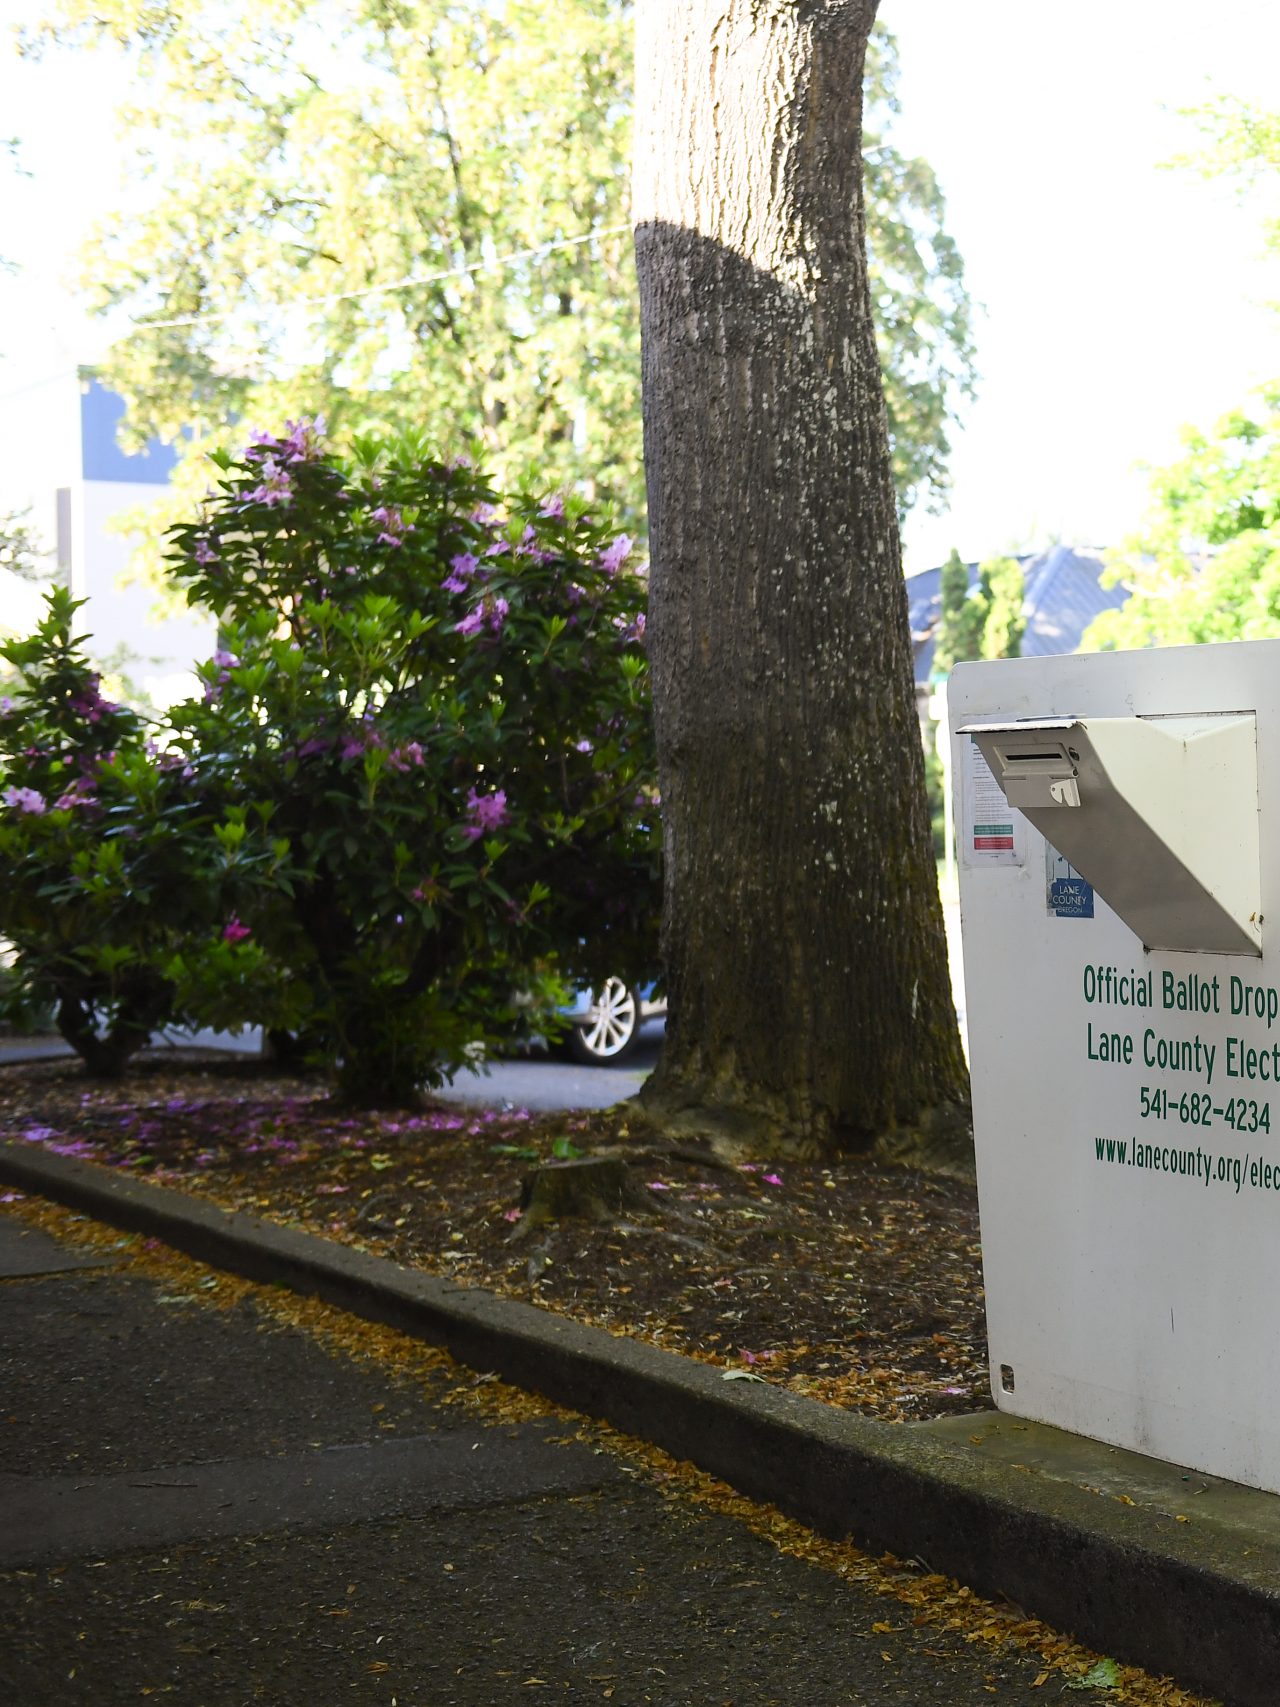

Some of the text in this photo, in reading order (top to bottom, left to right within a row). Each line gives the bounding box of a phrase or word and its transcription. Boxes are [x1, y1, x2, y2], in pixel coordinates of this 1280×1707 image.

[1052, 895, 1087, 905] COUNTY
[1059, 885, 1080, 894] LANE
[1083, 964, 1153, 1008] Official
[1162, 970, 1220, 1014] Ballot
[1230, 975, 1278, 1029] Drop
[1087, 1022, 1134, 1065] Lane
[1143, 1028, 1216, 1084] County
[1140, 1086, 1271, 1135] 541-682-4234
